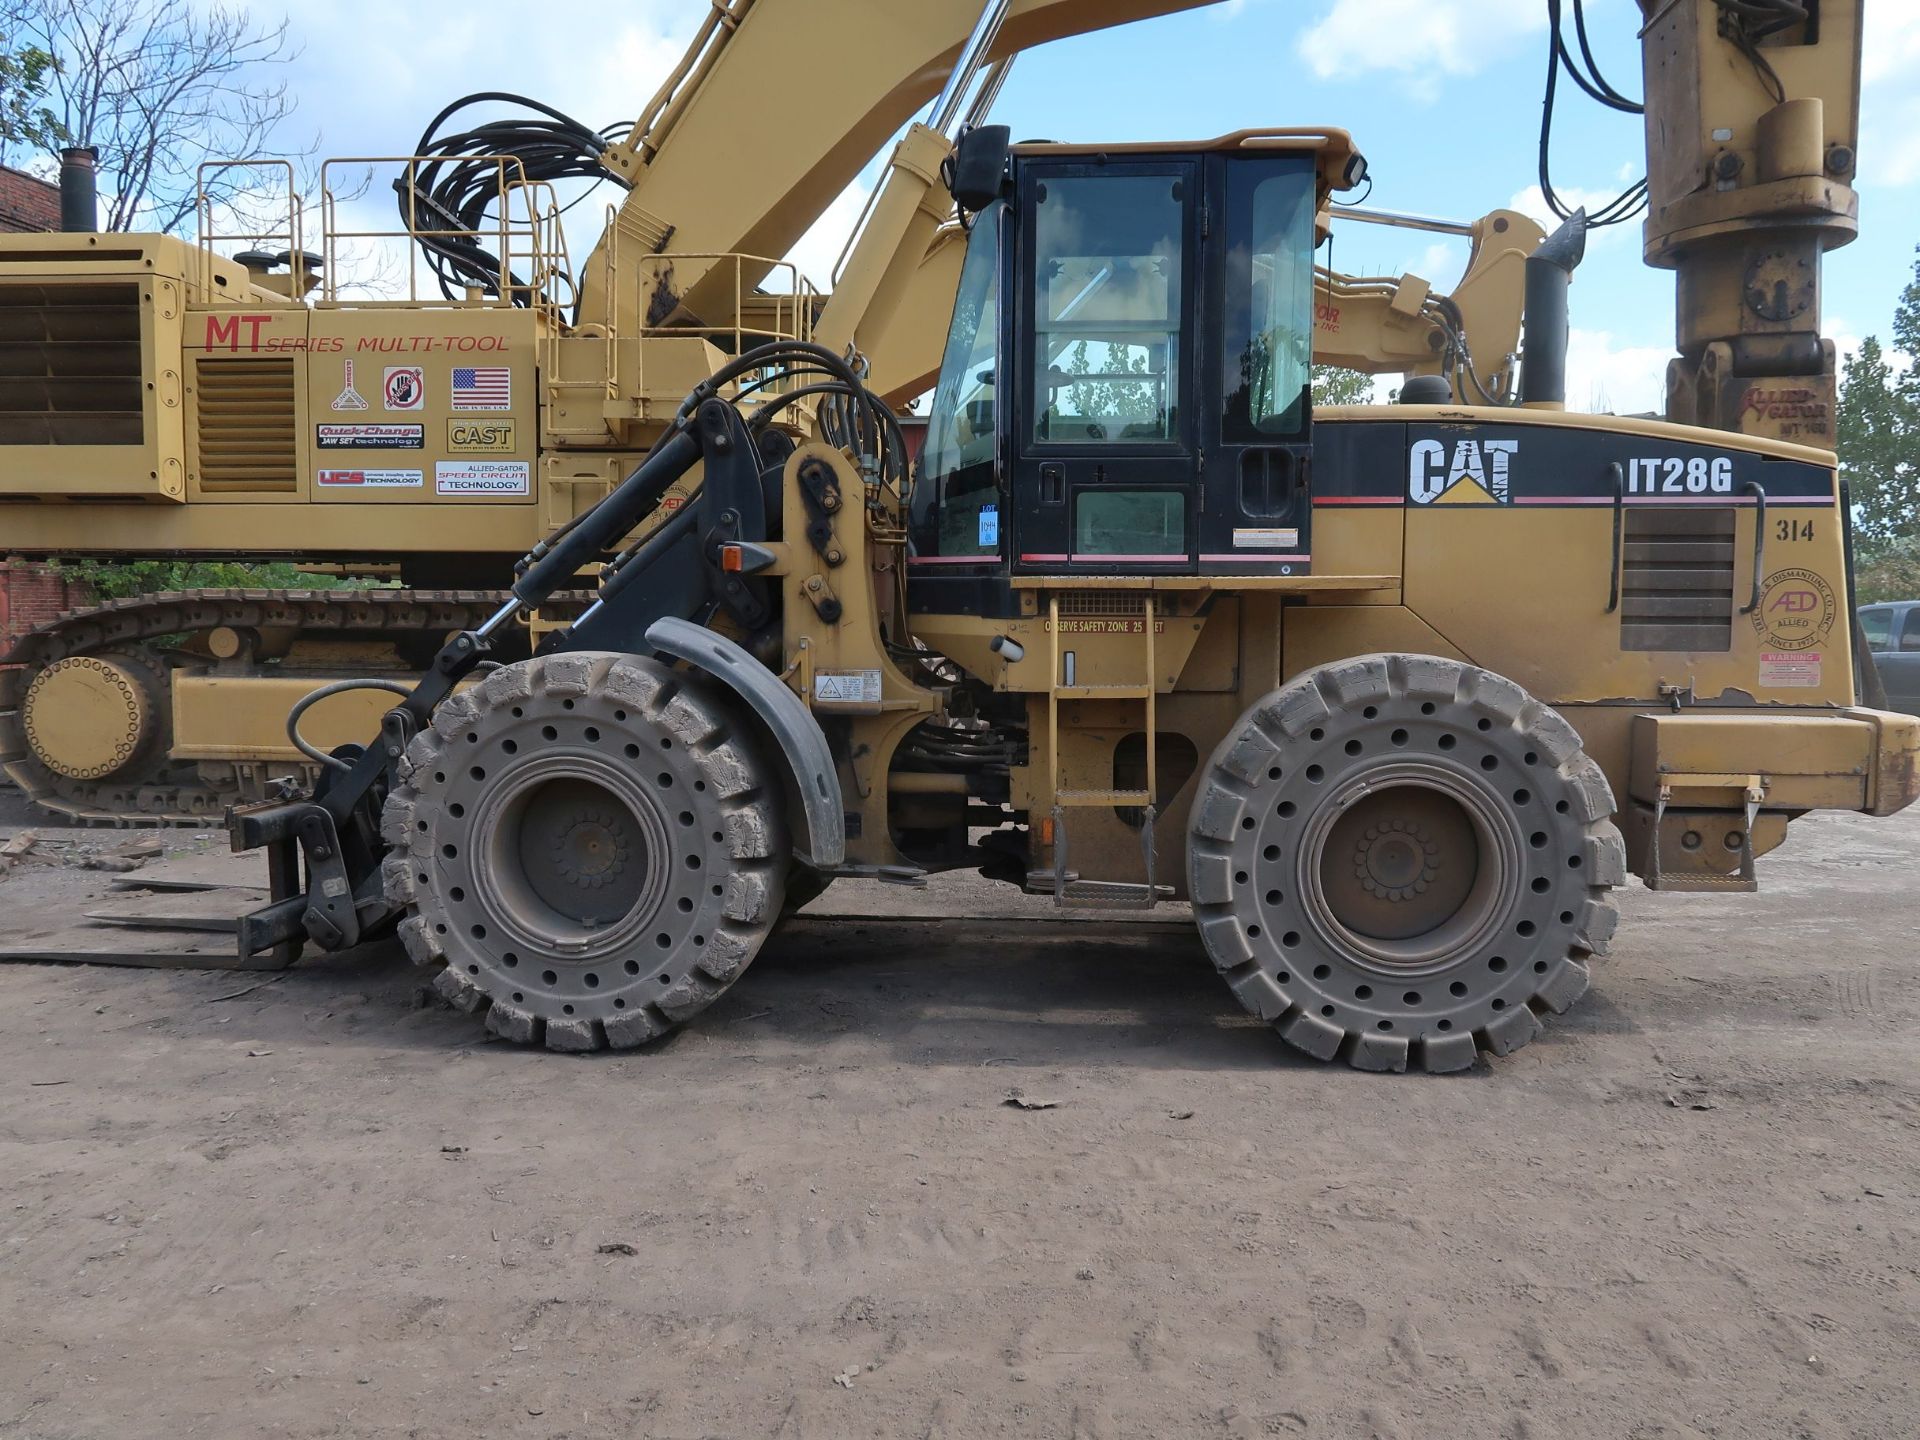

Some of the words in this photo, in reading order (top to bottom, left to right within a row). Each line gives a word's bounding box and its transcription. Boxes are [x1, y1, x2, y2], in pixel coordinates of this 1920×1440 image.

[206, 315, 272, 353] MT
[264, 337, 345, 353] SERIES
[356, 336, 511, 353] MULTI-TOOL
[320, 426, 422, 437] Quick-Change
[451, 426, 511, 444] CAST
[355, 437, 420, 446] technology
[1409, 439, 1519, 505] CAT
[1628, 457, 1733, 493] IT28G
[448, 481, 519, 489] TECHNOLOGY
[982, 504, 996, 512] LOT
[1776, 520, 1815, 541] 314
[1772, 571, 1827, 592] DISMANTLING
[1769, 591, 1818, 612] AED
[1044, 621, 1078, 632] OSERVE
[1079, 621, 1106, 632] SAFETY
[1108, 621, 1129, 632] ZONE
[1133, 621, 1142, 632] 25
[1778, 618, 1809, 628] ALLIED
[1769, 637, 1793, 649] SINCE
[1767, 653, 1812, 661] WARNING
